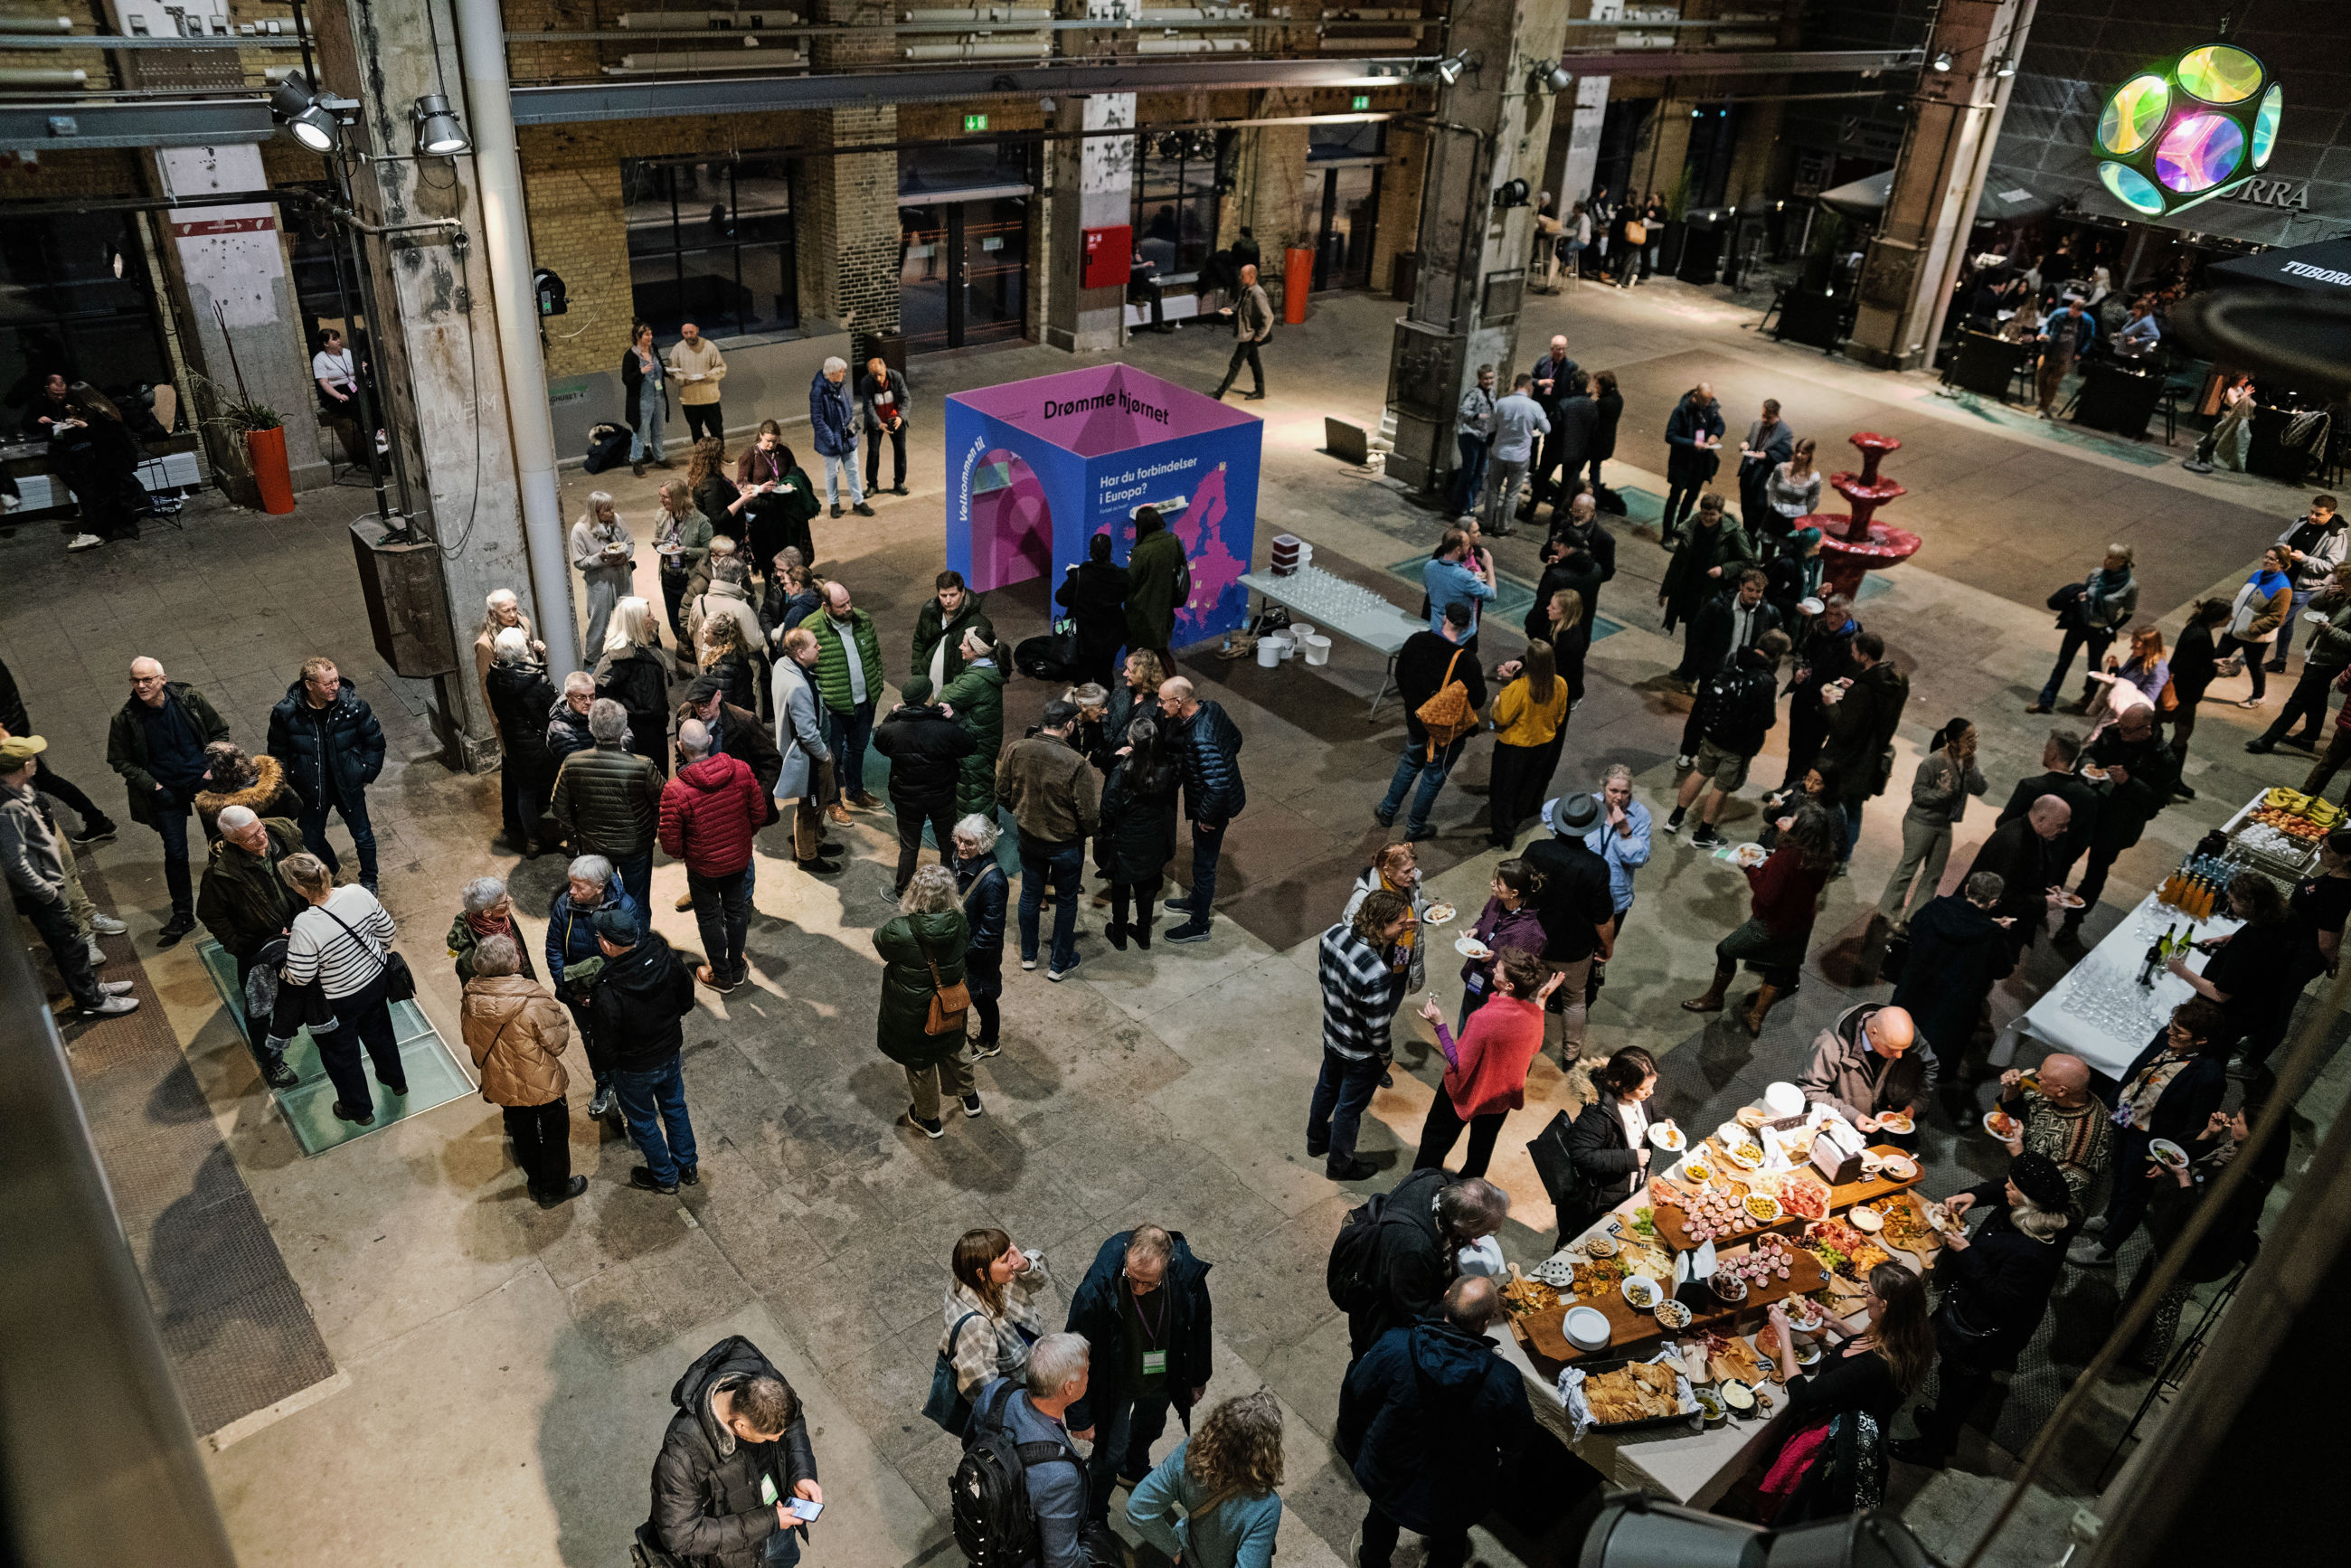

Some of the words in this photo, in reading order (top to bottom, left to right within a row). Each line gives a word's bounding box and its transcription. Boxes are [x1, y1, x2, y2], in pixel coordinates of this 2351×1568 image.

[1044, 392, 1116, 420] Drømme
[1119, 388, 1169, 425] hjørnet
[959, 447, 977, 522] Velkommen
[974, 435, 986, 452] til
[1100, 476, 1119, 489] Har
[1121, 471, 1135, 484] du
[1137, 458, 1198, 480] forbindelser
[1099, 493, 1103, 505] i
[1105, 482, 1147, 504] Europa?
